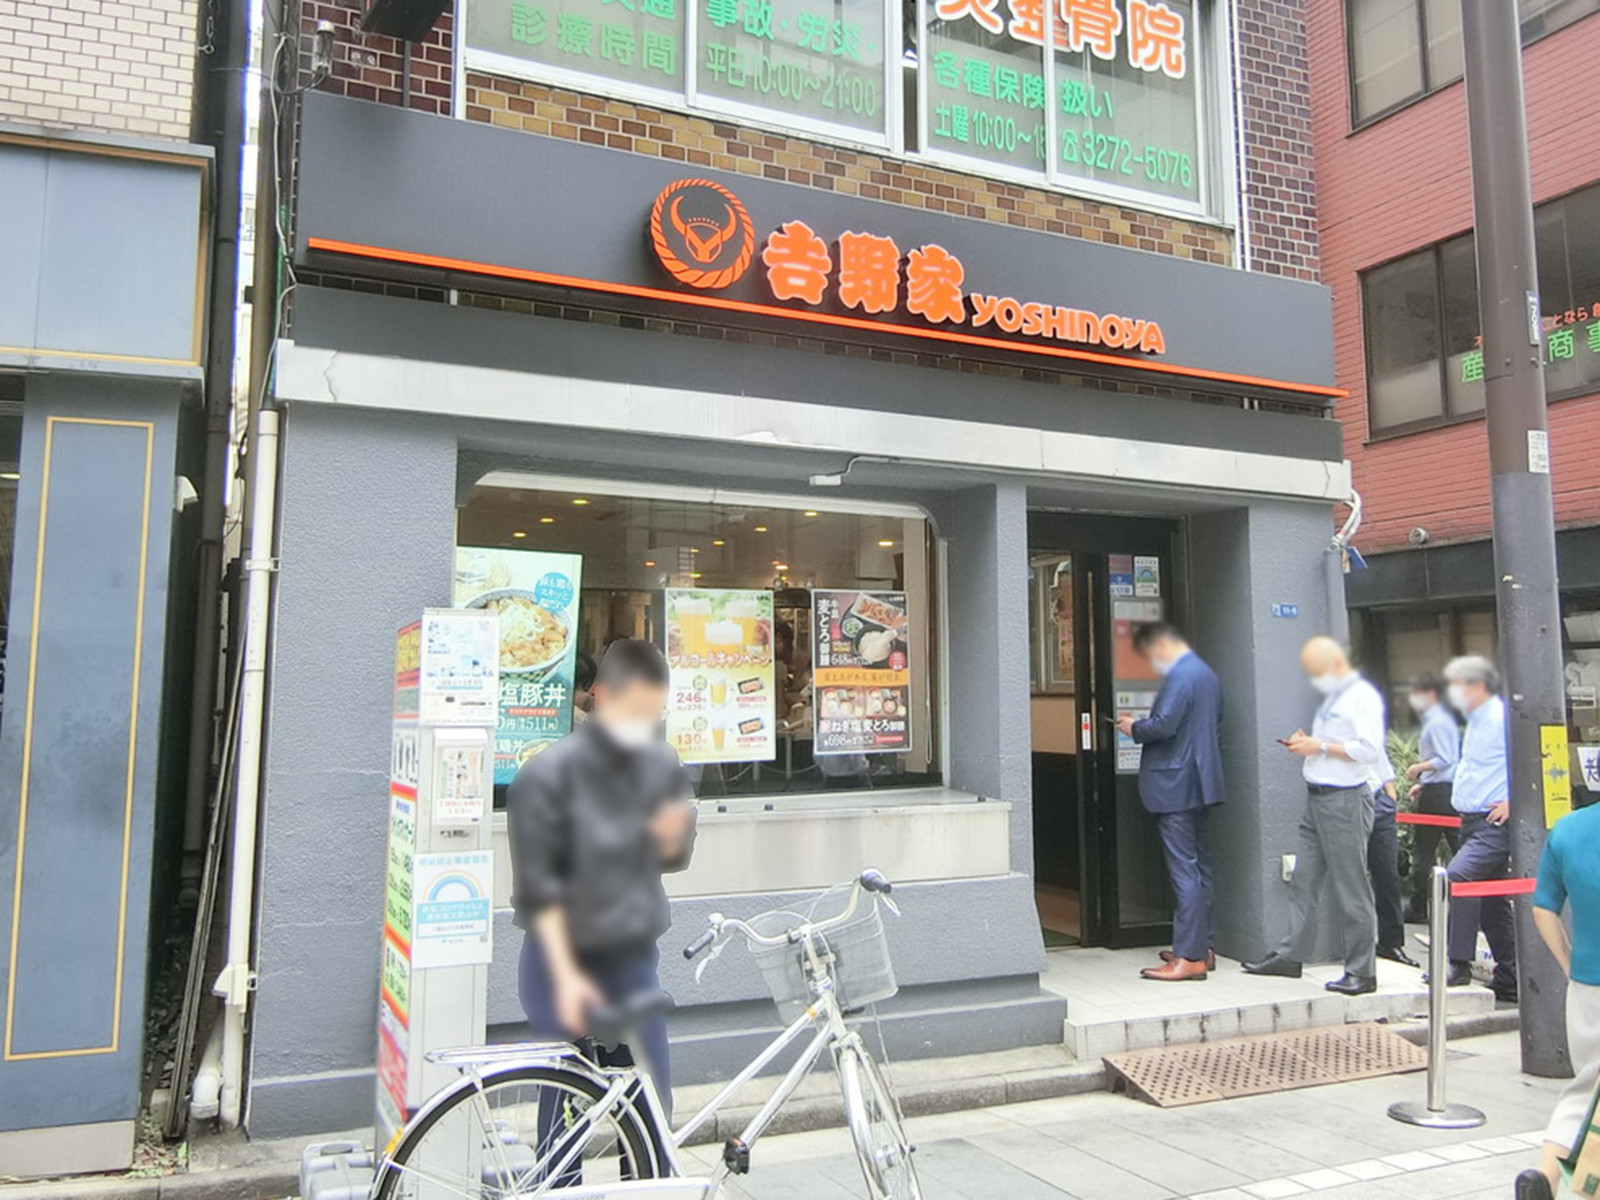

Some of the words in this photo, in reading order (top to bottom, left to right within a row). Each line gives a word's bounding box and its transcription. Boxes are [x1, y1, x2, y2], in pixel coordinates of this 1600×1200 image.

[510, 2, 677, 76] 診療時間
[933, 51, 1045, 109] 各種保険
[1062, 79, 1113, 118] 扱い
[1082, 132, 1193, 188] 3272-5076
[762, 219, 965, 325] 吉野家
